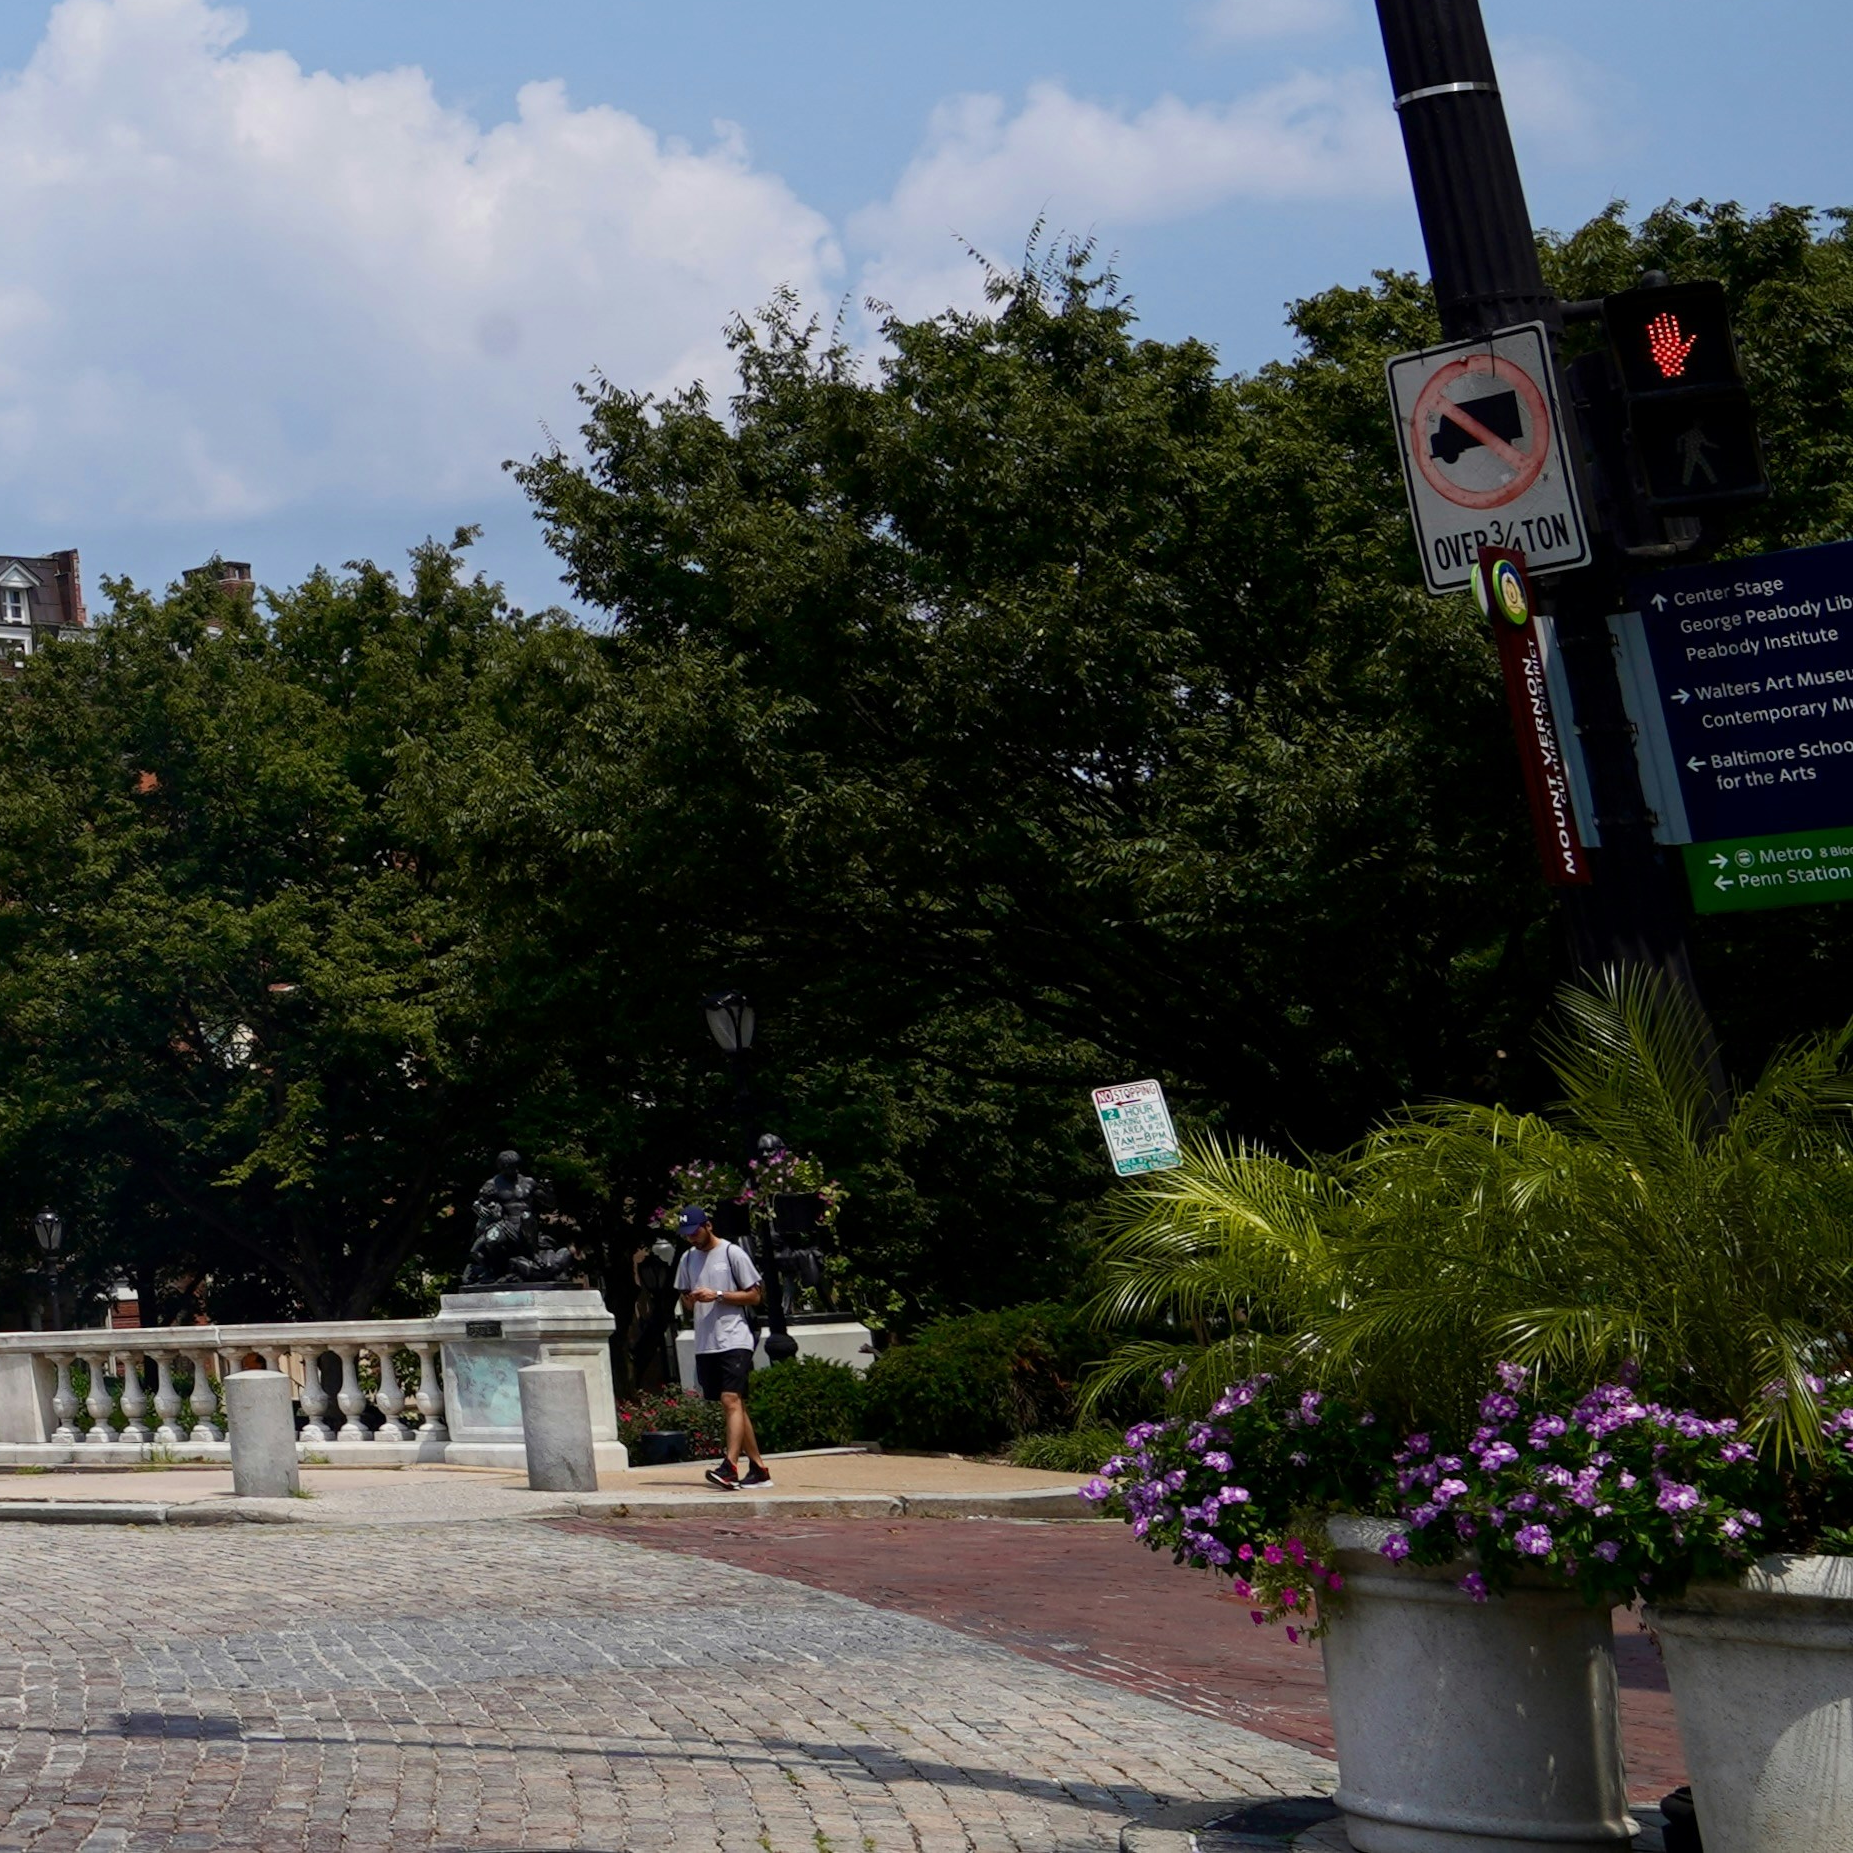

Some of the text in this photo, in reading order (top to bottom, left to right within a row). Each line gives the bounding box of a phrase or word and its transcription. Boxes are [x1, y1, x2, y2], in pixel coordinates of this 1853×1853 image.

[1521, 513, 1571, 553] TON
[1673, 578, 1784, 606] Center Stage
[1680, 595, 1853, 633] George Peabody Lib
[1685, 628, 1839, 661] Peabody Institute
[1694, 680, 1761, 700] Walters
[1765, 675, 1794, 692] Art
[1701, 701, 1827, 728] Contemporary
[1522, 657, 1576, 874] MOUNT VERNON
[1710, 747, 1795, 769] Baltimore
[1716, 766, 1817, 790] for the Arts
[1759, 847, 1813, 864] Metro
[1819, 847, 1829, 858] 8
[1738, 865, 1851, 888] Penn Station
[1097, 1085, 1156, 1103] NO STOPPING
[1107, 1104, 1153, 1119] 2 HOUR
[1108, 1113, 1162, 1128] PARKING LIMIT
[1123, 1125, 1145, 1134] AREA
